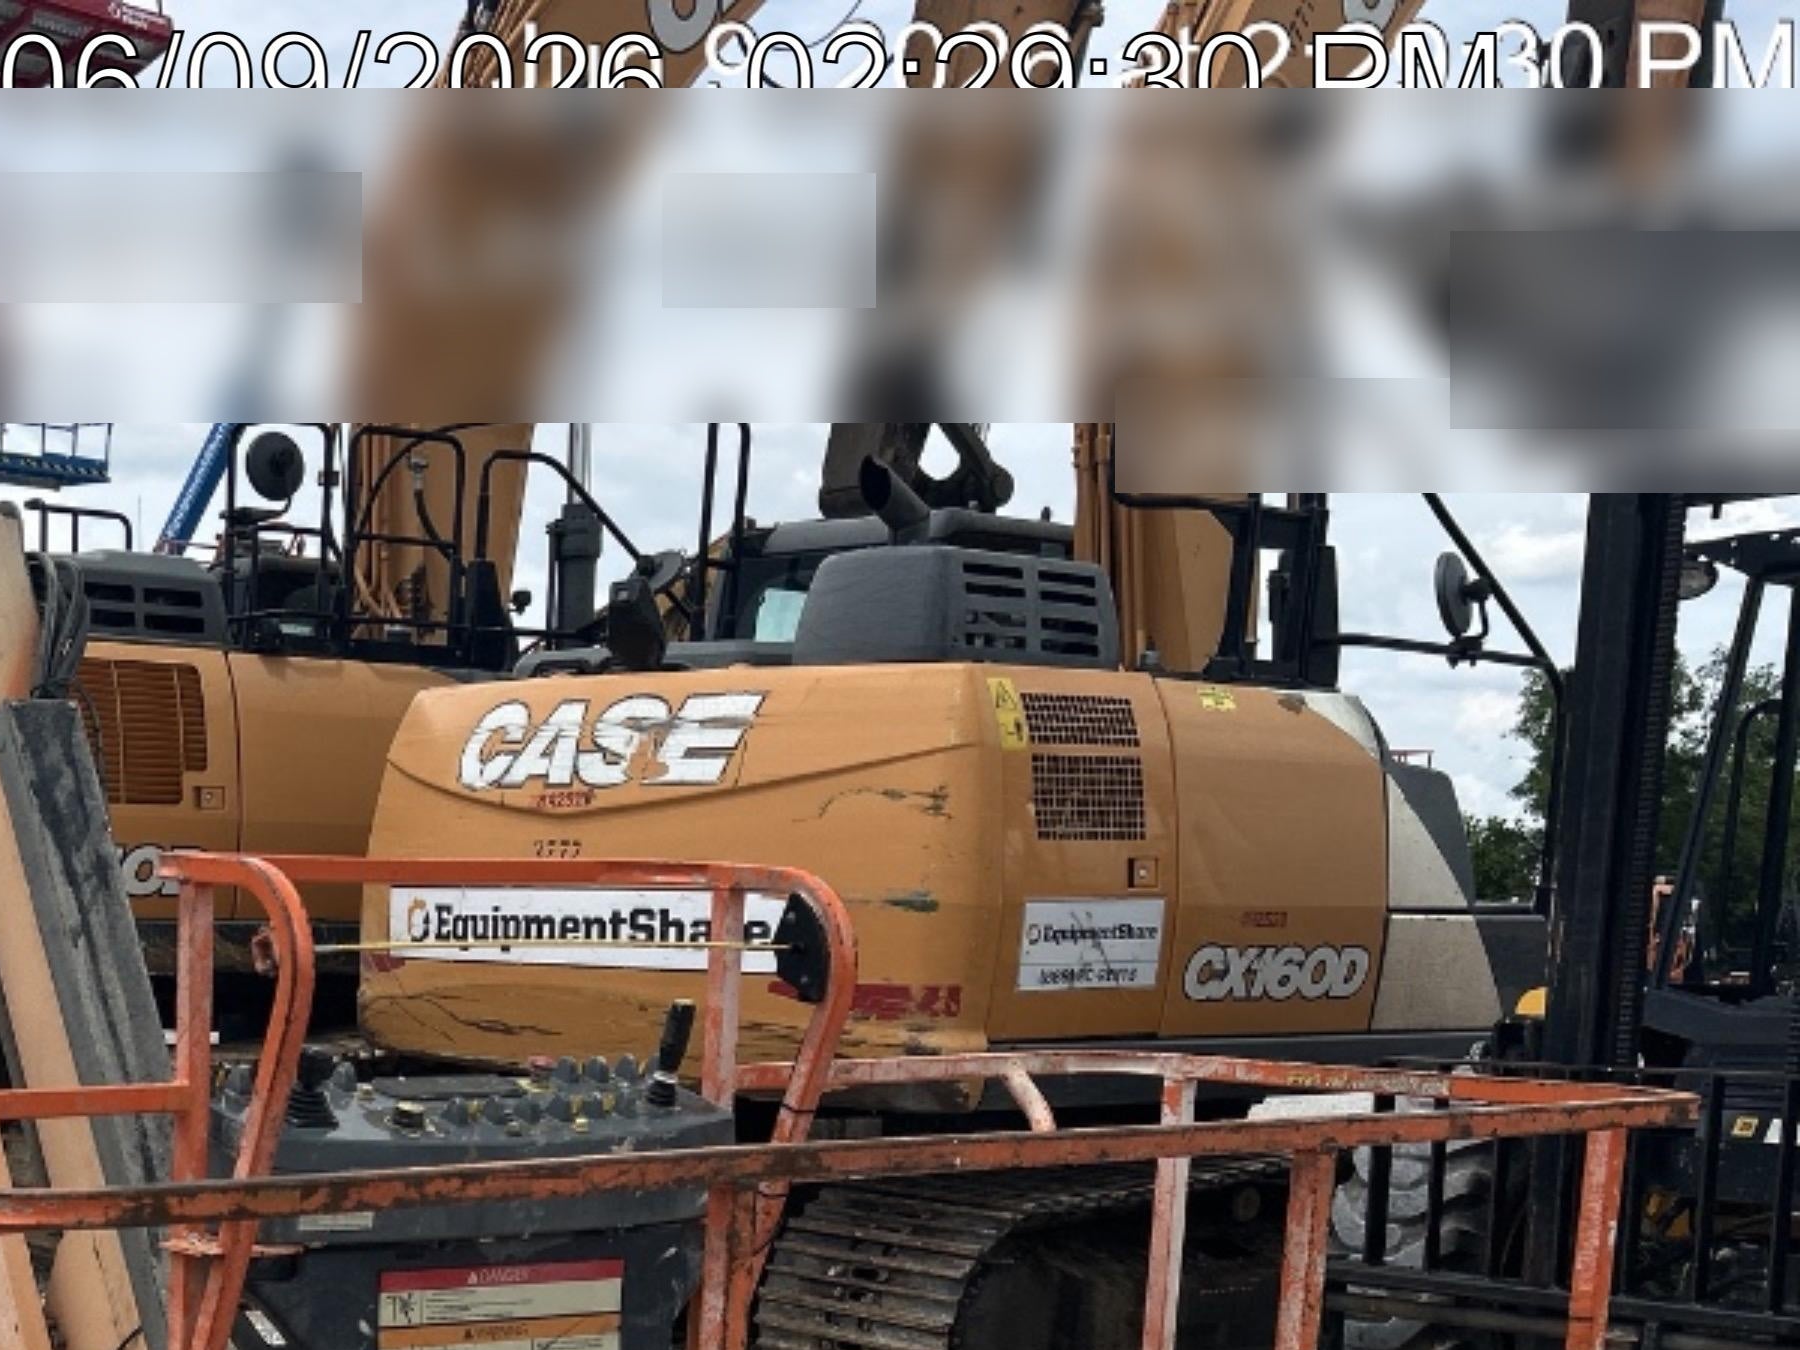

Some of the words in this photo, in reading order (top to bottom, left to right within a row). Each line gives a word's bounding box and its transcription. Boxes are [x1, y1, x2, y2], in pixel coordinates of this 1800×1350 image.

[457, 692, 768, 790] CASE
[434, 903, 775, 951] EquipmentShae
[1183, 942, 1370, 1002] CX160D
